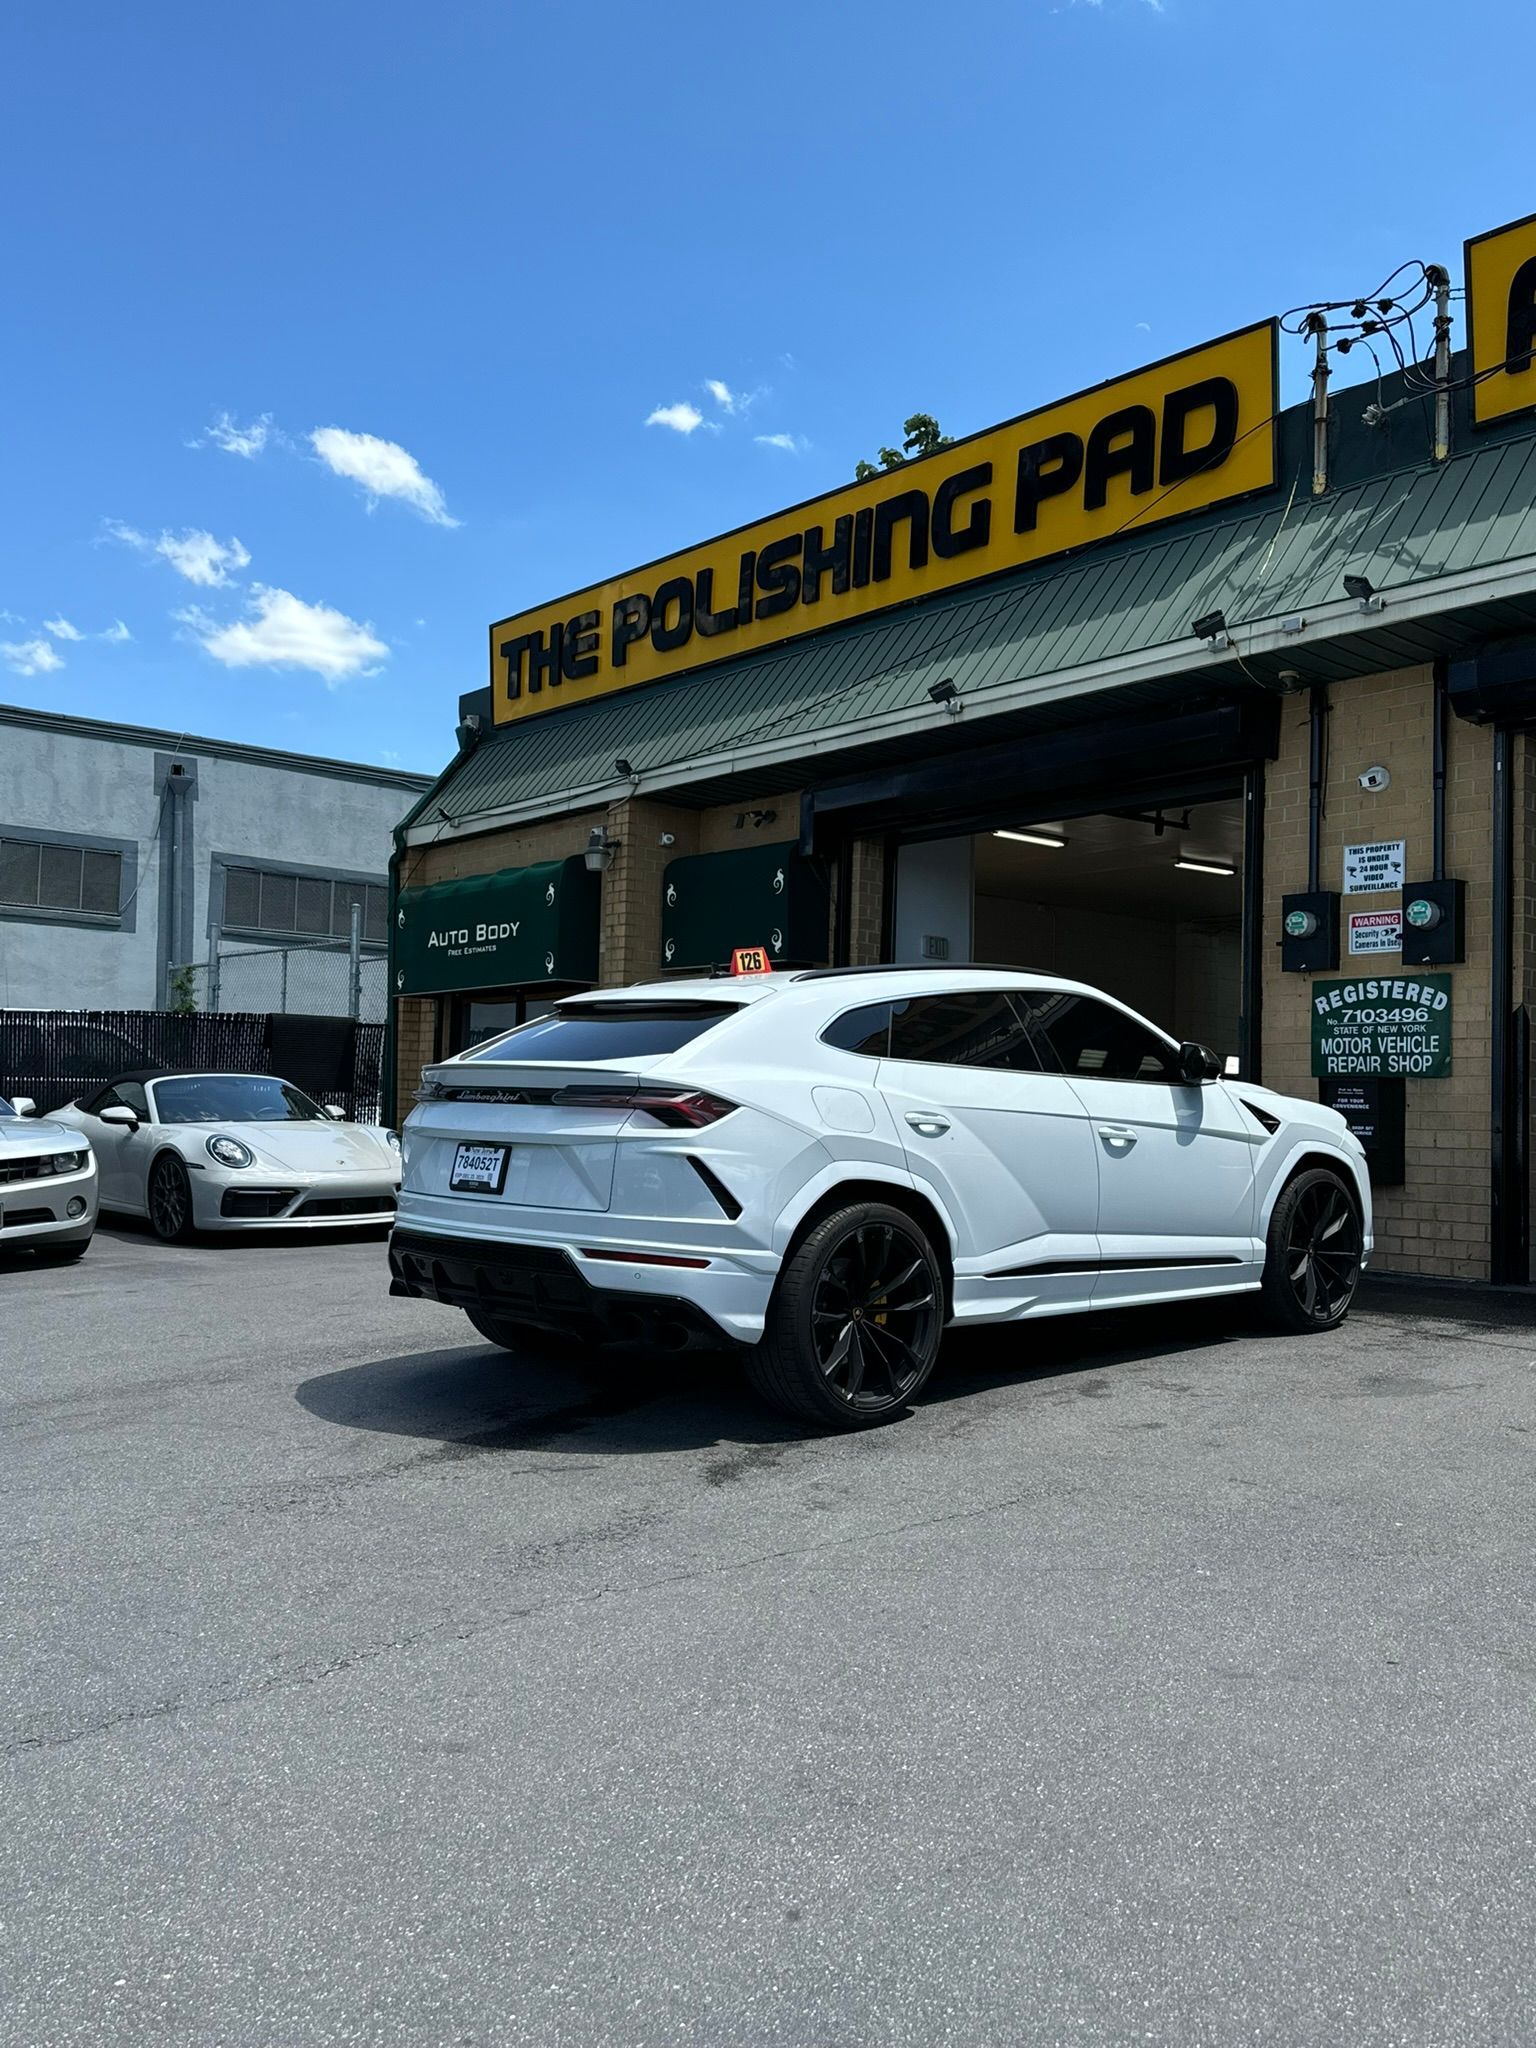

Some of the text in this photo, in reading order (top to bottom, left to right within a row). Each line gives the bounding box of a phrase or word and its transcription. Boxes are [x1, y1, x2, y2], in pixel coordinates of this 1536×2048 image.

[501, 376, 1239, 699] THE POLISHING PAD
[1348, 844, 1400, 856] THIS PROPERTY
[1367, 854, 1390, 863] UNDER
[1369, 864, 1388, 872] HOUR
[1364, 873, 1384, 882] VIDEO
[1349, 881, 1398, 892] SURVEILLANCE
[1354, 914, 1399, 927] WARNING
[1355, 930, 1379, 939] Security
[1354, 940, 1379, 949] Cameras
[739, 952, 762, 971] 126
[1314, 980, 1448, 1015] REGISTERED
[1341, 1008, 1429, 1023] 7103496
[1333, 1024, 1427, 1035] STATE OF NEW YORK
[1321, 1035, 1440, 1055] MOTOR VEHICLE
[1327, 1055, 1433, 1073] REPAIR SHOP
[458, 1155, 500, 1172] 784052T
